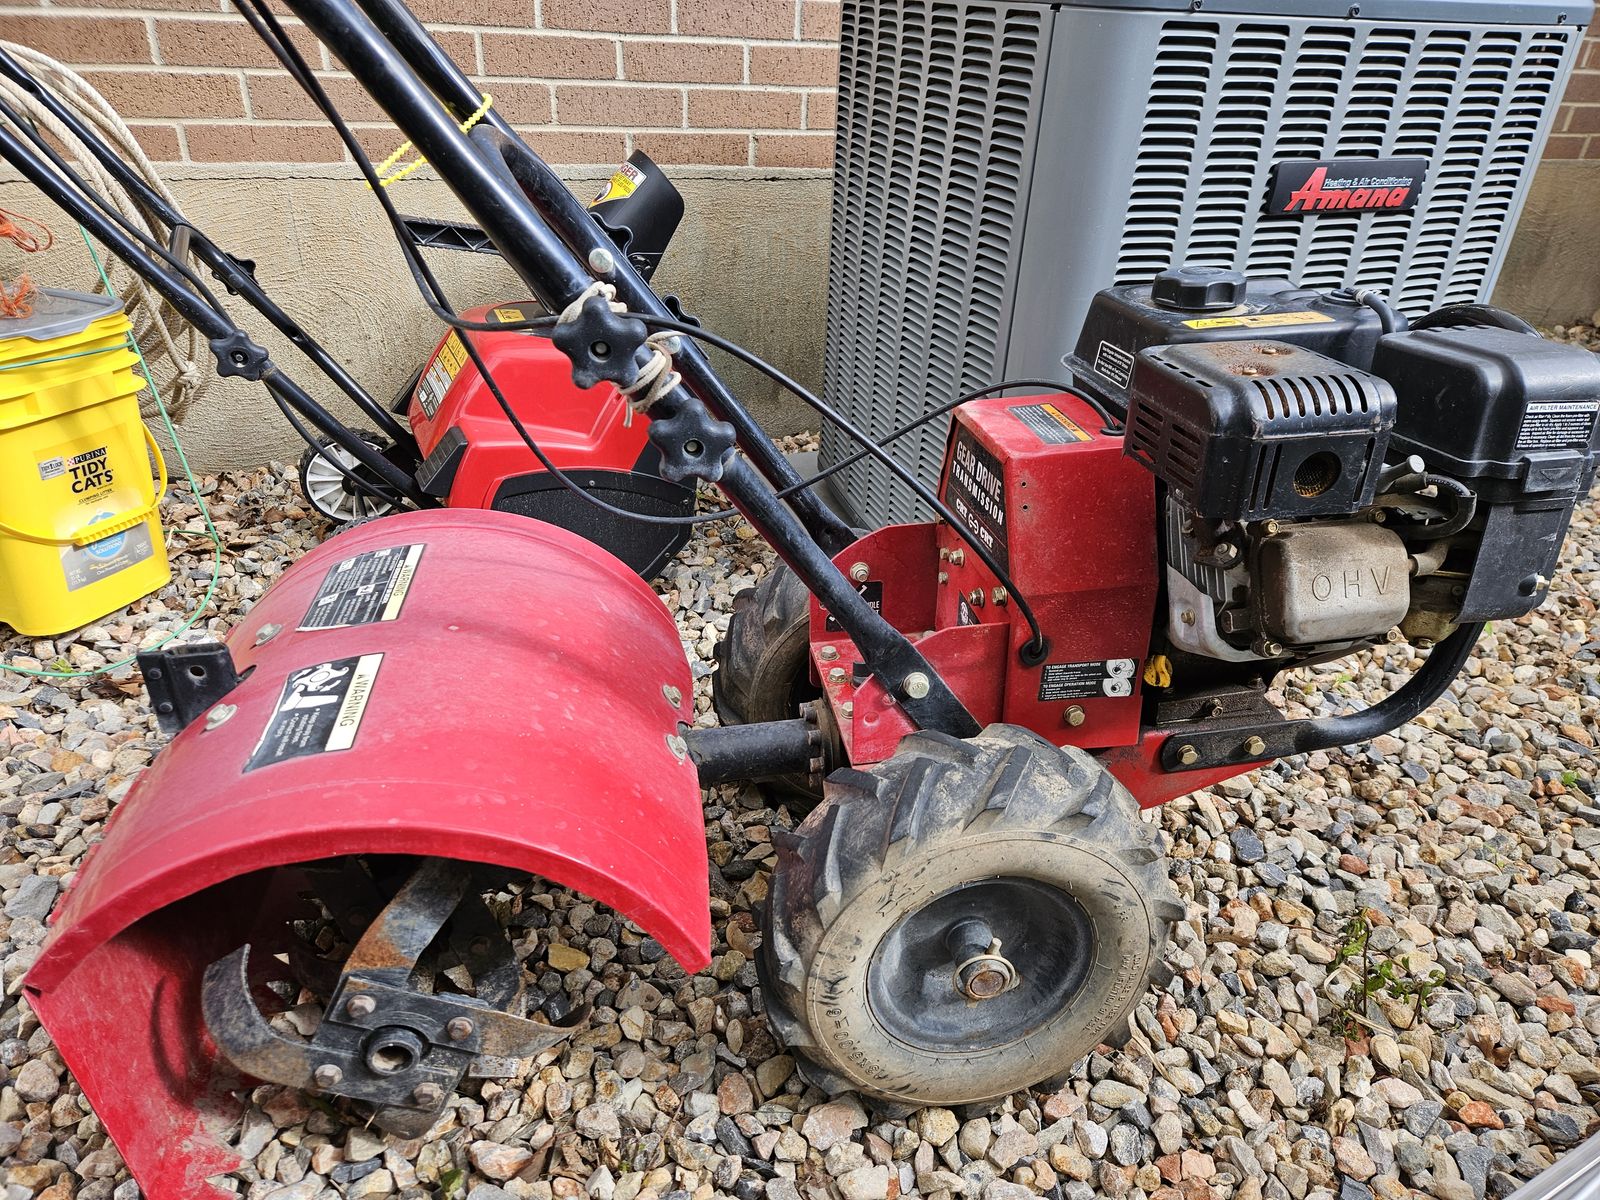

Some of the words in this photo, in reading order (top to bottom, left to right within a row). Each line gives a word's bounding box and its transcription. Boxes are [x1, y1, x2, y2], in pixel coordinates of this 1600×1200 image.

[1283, 167, 1410, 211] Amana
[1324, 178, 1352, 187] Heating
[1352, 178, 1358, 186] &
[1371, 176, 1412, 186] Conditioning
[69, 457, 107, 480] TIDY
[75, 449, 106, 464] PURINA
[956, 440, 976, 476] GEAR
[976, 461, 1002, 502] DRIVE
[72, 470, 113, 493] CATS
[952, 460, 1003, 525] TRANSMISSION
[394, 568, 412, 596] WARNING
[1312, 566, 1390, 601] OHV
[340, 678, 369, 727] WARNING
